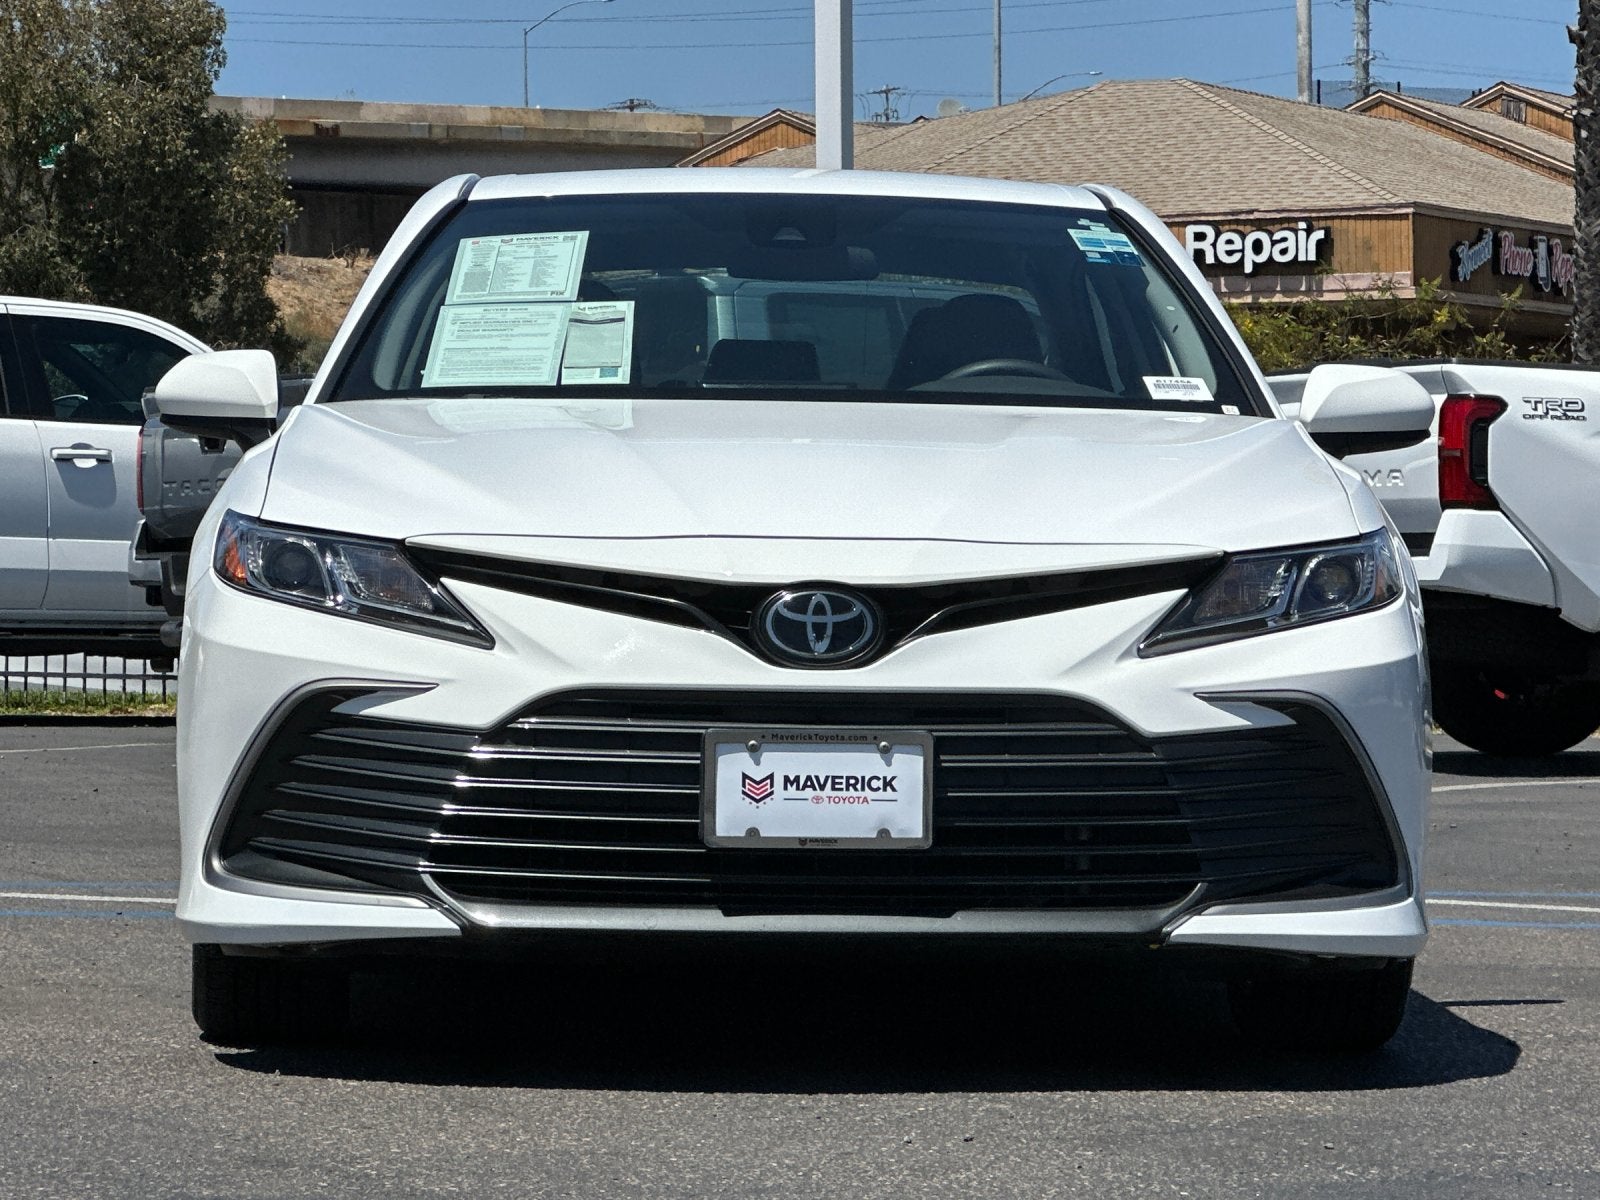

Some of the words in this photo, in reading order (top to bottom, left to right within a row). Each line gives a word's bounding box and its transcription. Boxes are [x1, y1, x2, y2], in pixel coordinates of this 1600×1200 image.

[1185, 221, 1325, 274] Repair
[1498, 230, 1534, 277] Phone
[1522, 396, 1585, 415] TRD
[770, 732, 869, 743] MaverickToyota.com
[782, 774, 899, 793] MAVERICK
[825, 795, 870, 805] TOYOTA
